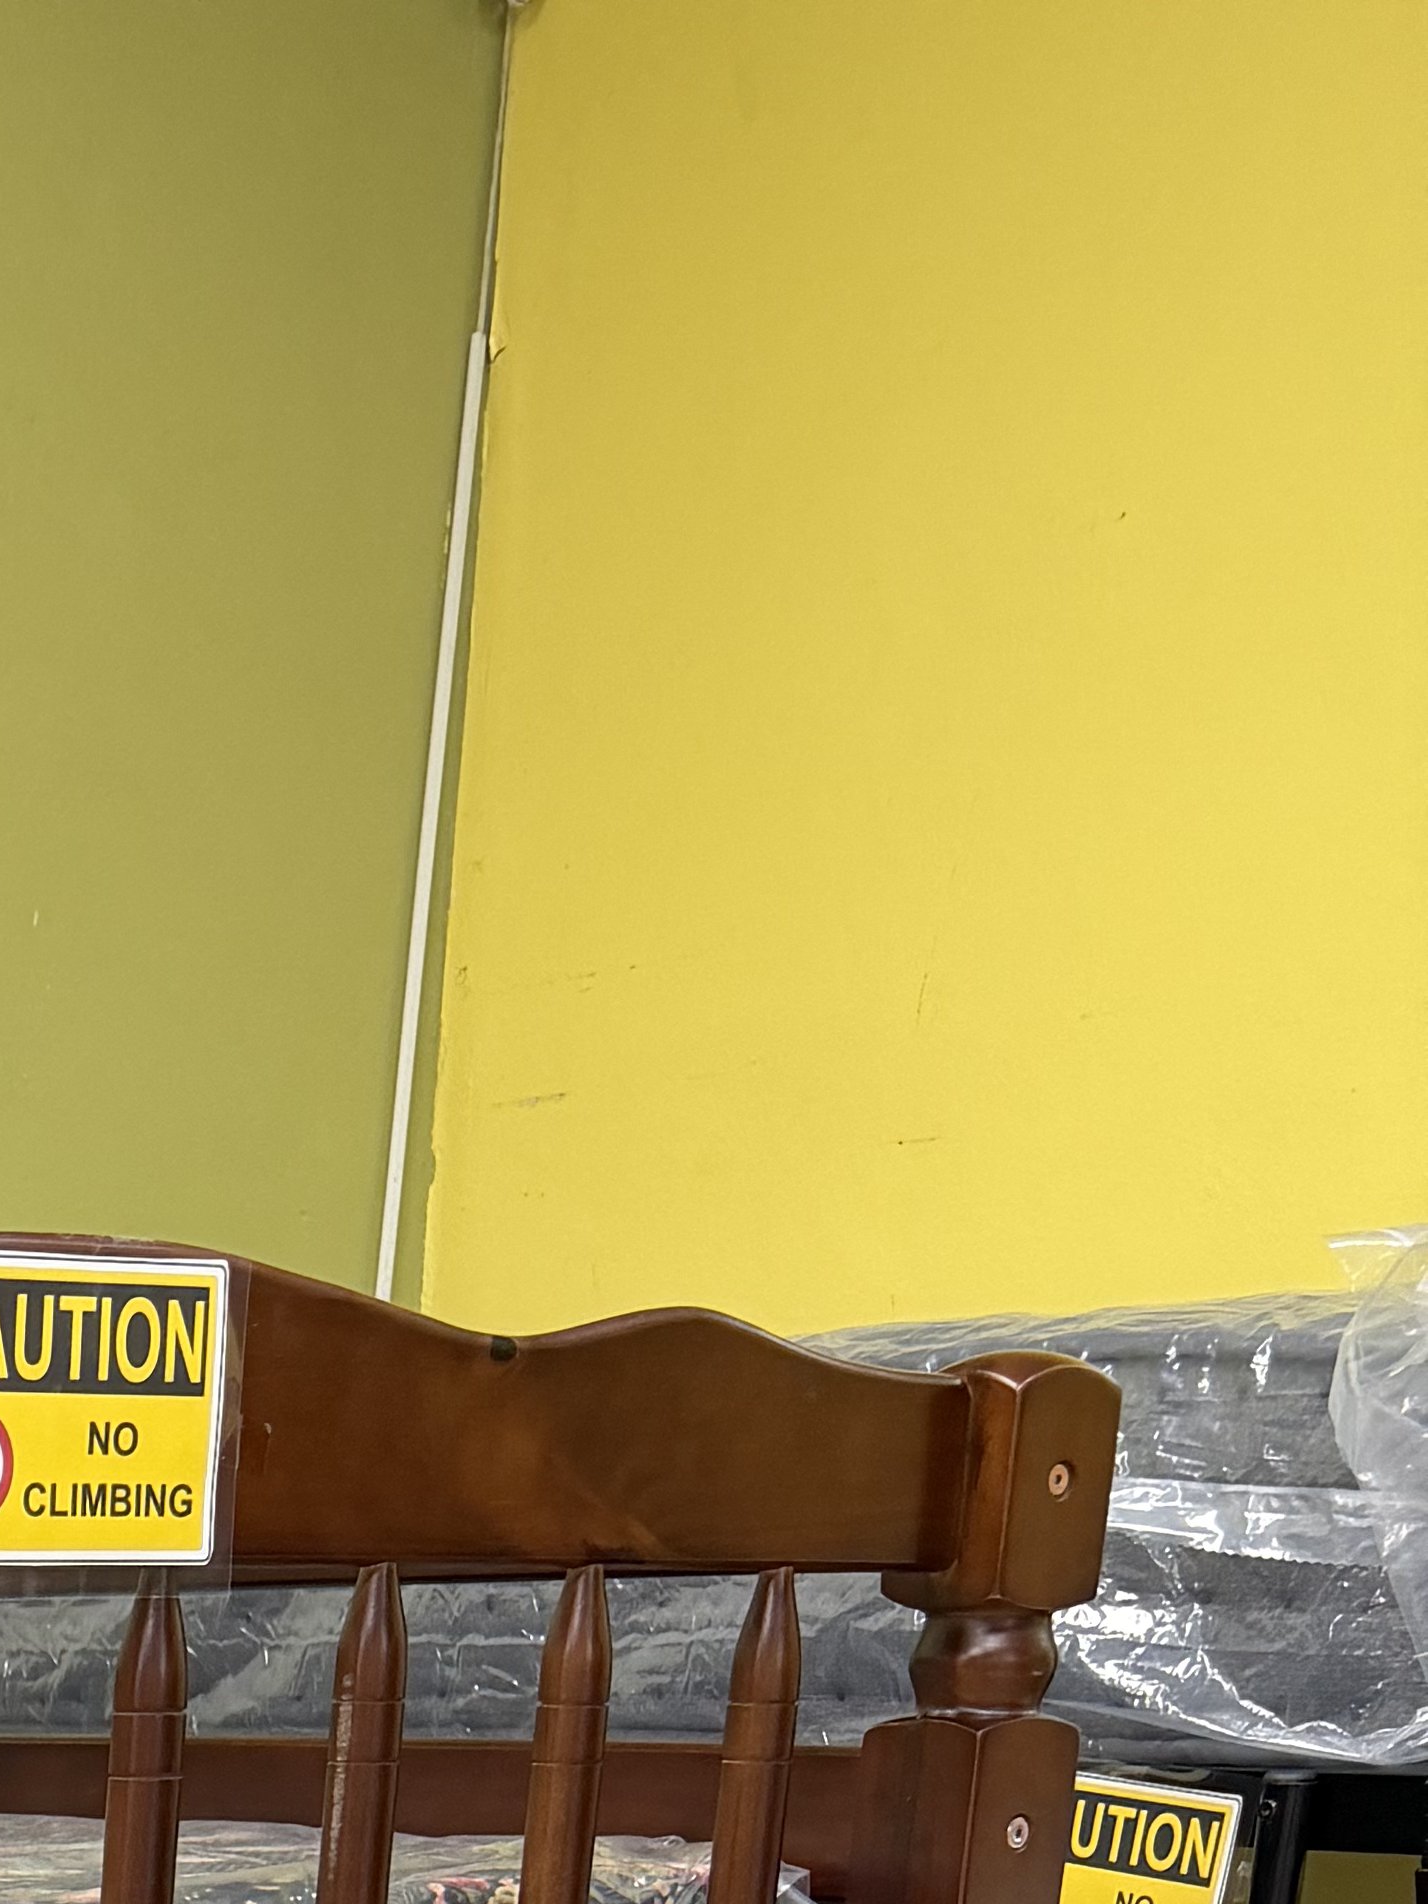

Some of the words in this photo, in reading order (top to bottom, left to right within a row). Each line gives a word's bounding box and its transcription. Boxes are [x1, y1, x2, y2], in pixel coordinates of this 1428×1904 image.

[87, 1421, 139, 1457] NO
[23, 1481, 193, 1518] CLIMBING
[1069, 1799, 1221, 1880] UTION
